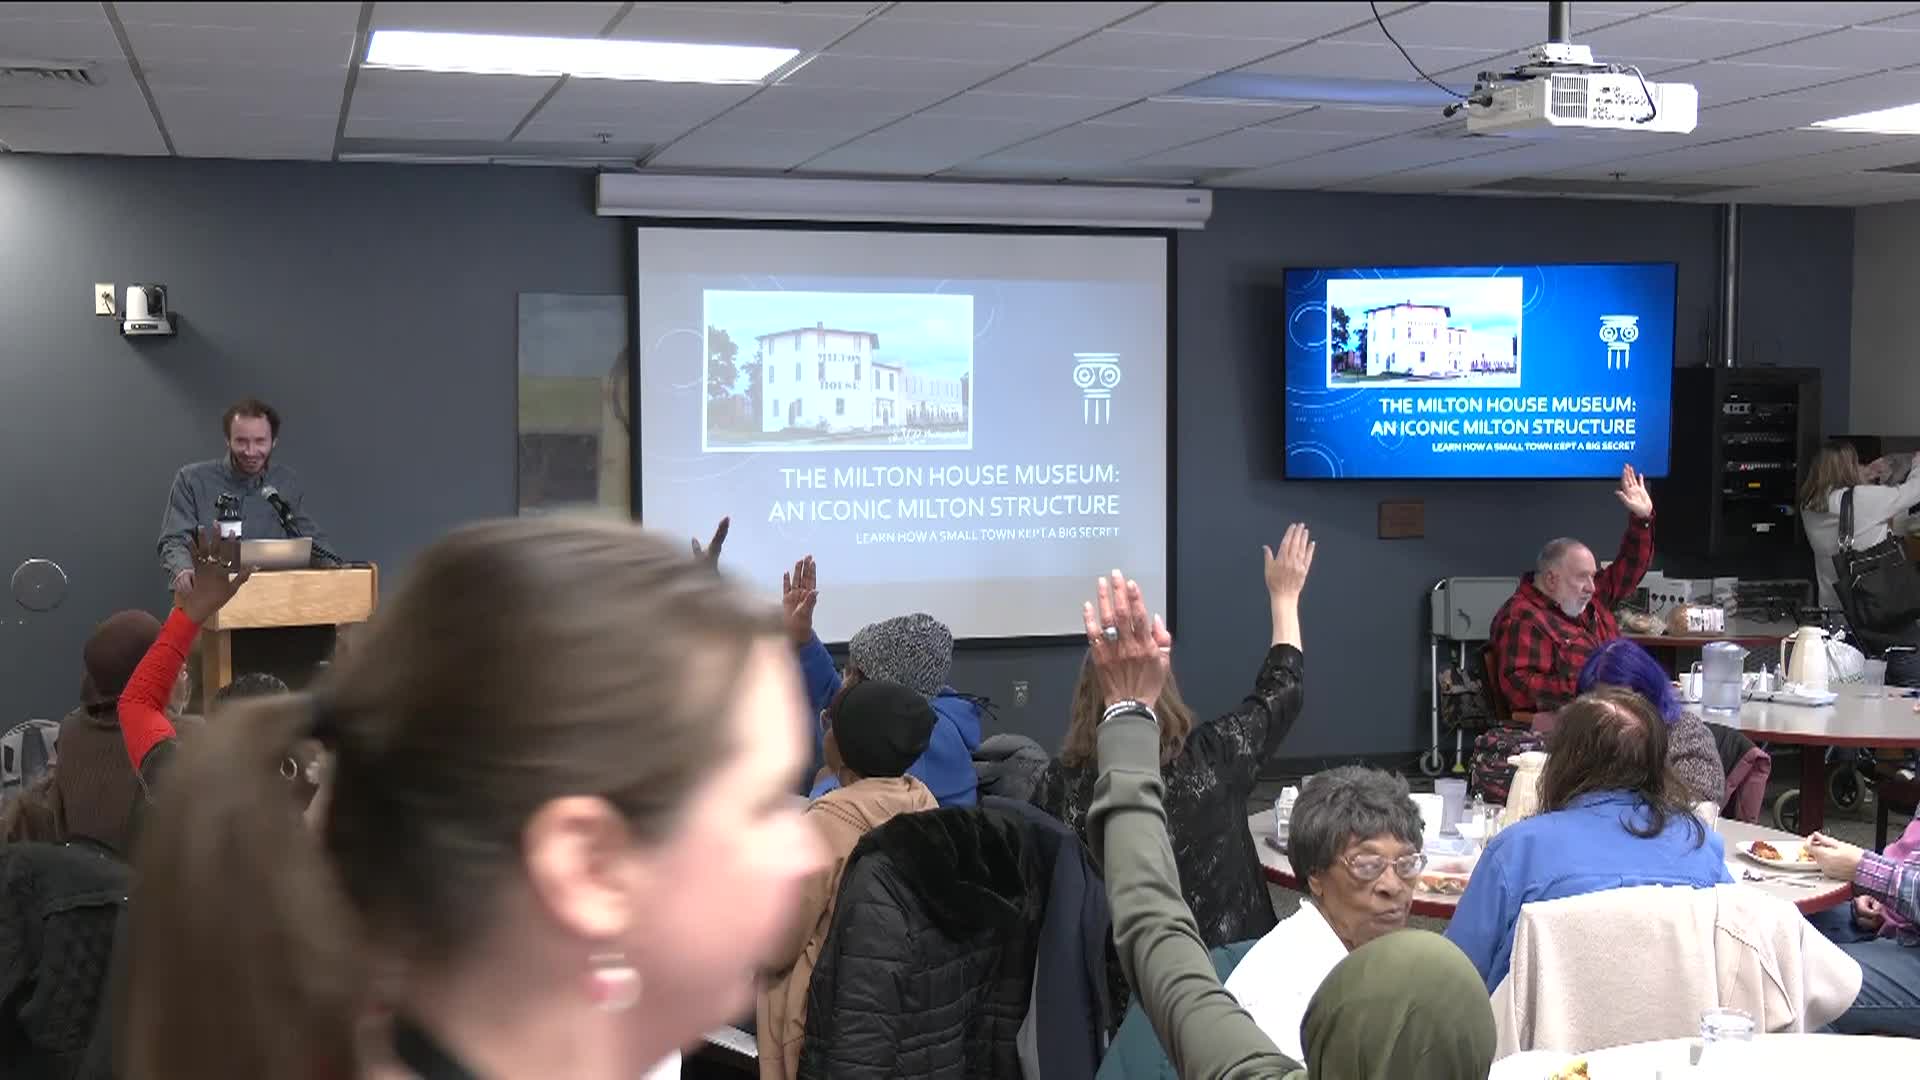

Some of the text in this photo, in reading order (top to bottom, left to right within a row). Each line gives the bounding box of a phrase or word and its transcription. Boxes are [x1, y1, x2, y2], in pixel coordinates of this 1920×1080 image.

[1378, 396, 1636, 414] THE MILTON HOUSE MUSEUM:
[1370, 418, 1636, 436] AN ICONIC MILTON STRUCTURE
[1431, 441, 1636, 452] LEARN HOW A SMALL TOWN KEPT A BIG SECRET
[779, 463, 1120, 489] THE MILTON HOUSE MUSEUM:
[768, 494, 1120, 522] AN ICONIC MILTON STRUCTURE
[855, 526, 1120, 545] LEARN HOW A SMALL TOWN KEPT A BIG SECRET
